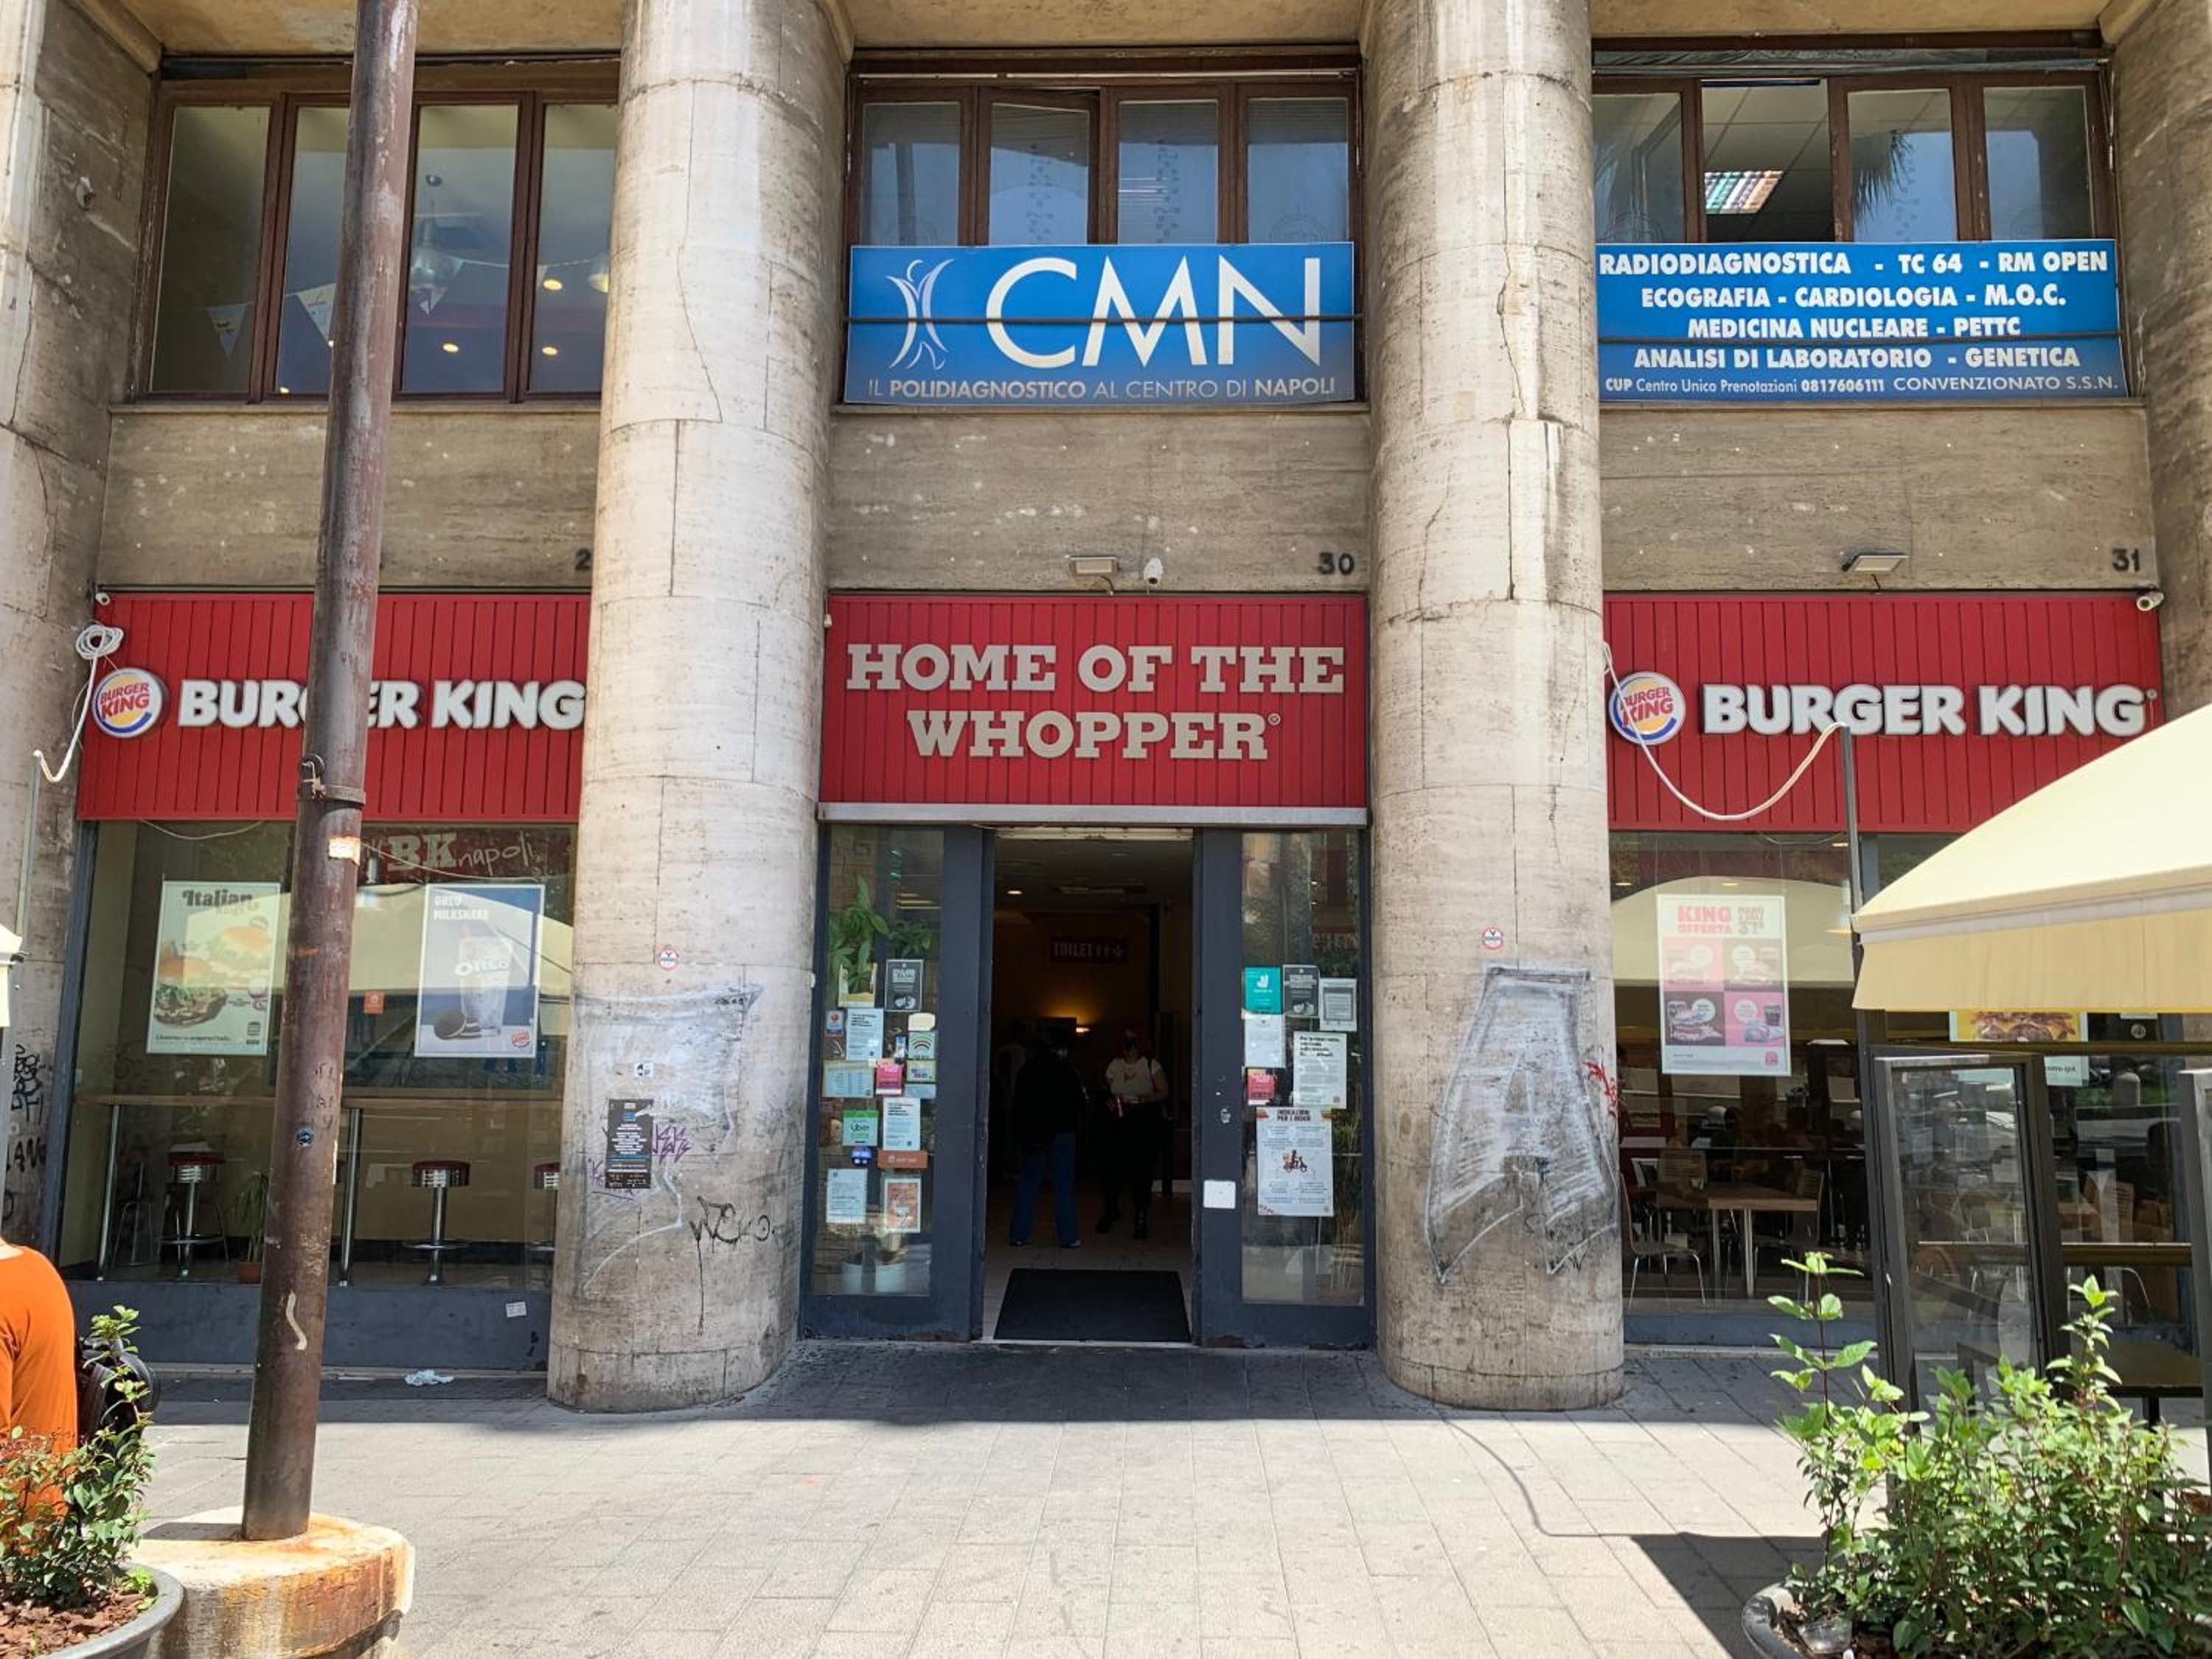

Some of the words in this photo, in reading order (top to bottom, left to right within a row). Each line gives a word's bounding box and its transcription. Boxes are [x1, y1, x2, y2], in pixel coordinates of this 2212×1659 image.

[1599, 253, 1850, 275] RADIODIAGNOSTICA
[1899, 254, 1925, 274] TC
[1932, 254, 1962, 274] 64
[1999, 253, 2035, 273] RM
[2042, 251, 2107, 272] OPEN
[1641, 286, 1770, 307] ECOGRAFIA
[1795, 285, 1957, 307] CARDIOLOGIA
[1984, 284, 2066, 306] M.O.C.
[985, 254, 1321, 367] CMN
[1688, 318, 1803, 338] MEDICINA
[1810, 317, 1928, 338] NUCLEARE
[1953, 316, 2020, 337] PETTC
[1634, 349, 1725, 369] ANALISI
[1734, 349, 1759, 369] DI
[1766, 348, 1931, 369] LABORATORIO
[1966, 347, 2080, 367] GENETICA
[868, 380, 884, 398] IL
[889, 380, 1086, 400] POLIDIAGNOSTICO
[1093, 380, 1119, 400] AL
[1125, 380, 1218, 399] CENTRO
[1225, 380, 1248, 398] DI
[1256, 377, 1335, 397] NAPOLI
[1605, 377, 1632, 392] CUP
[1636, 377, 1677, 393] Centro
[1681, 378, 1717, 393] Unico
[1720, 378, 1798, 394] Prenotazioni
[1801, 379, 1885, 393] 0817606111
[1893, 375, 2061, 391] CONVENZIONATO
[2067, 376, 2118, 389] S.S.N.
[1318, 552, 1355, 574] 30
[2112, 549, 2140, 571] 31
[846, 644, 1056, 692] HOME
[1078, 644, 1172, 692] OF
[1191, 646, 1345, 694] THE
[100, 682, 149, 705] BURGER
[431, 679, 586, 730] KING
[101, 694, 150, 720] KING
[1623, 698, 1672, 727] KING
[1703, 684, 1966, 736] BURGER
[387, 832, 457, 872] BK
[458, 830, 537, 877] napoli
[182, 888, 260, 911] Italian
[1677, 906, 1732, 922] KING
